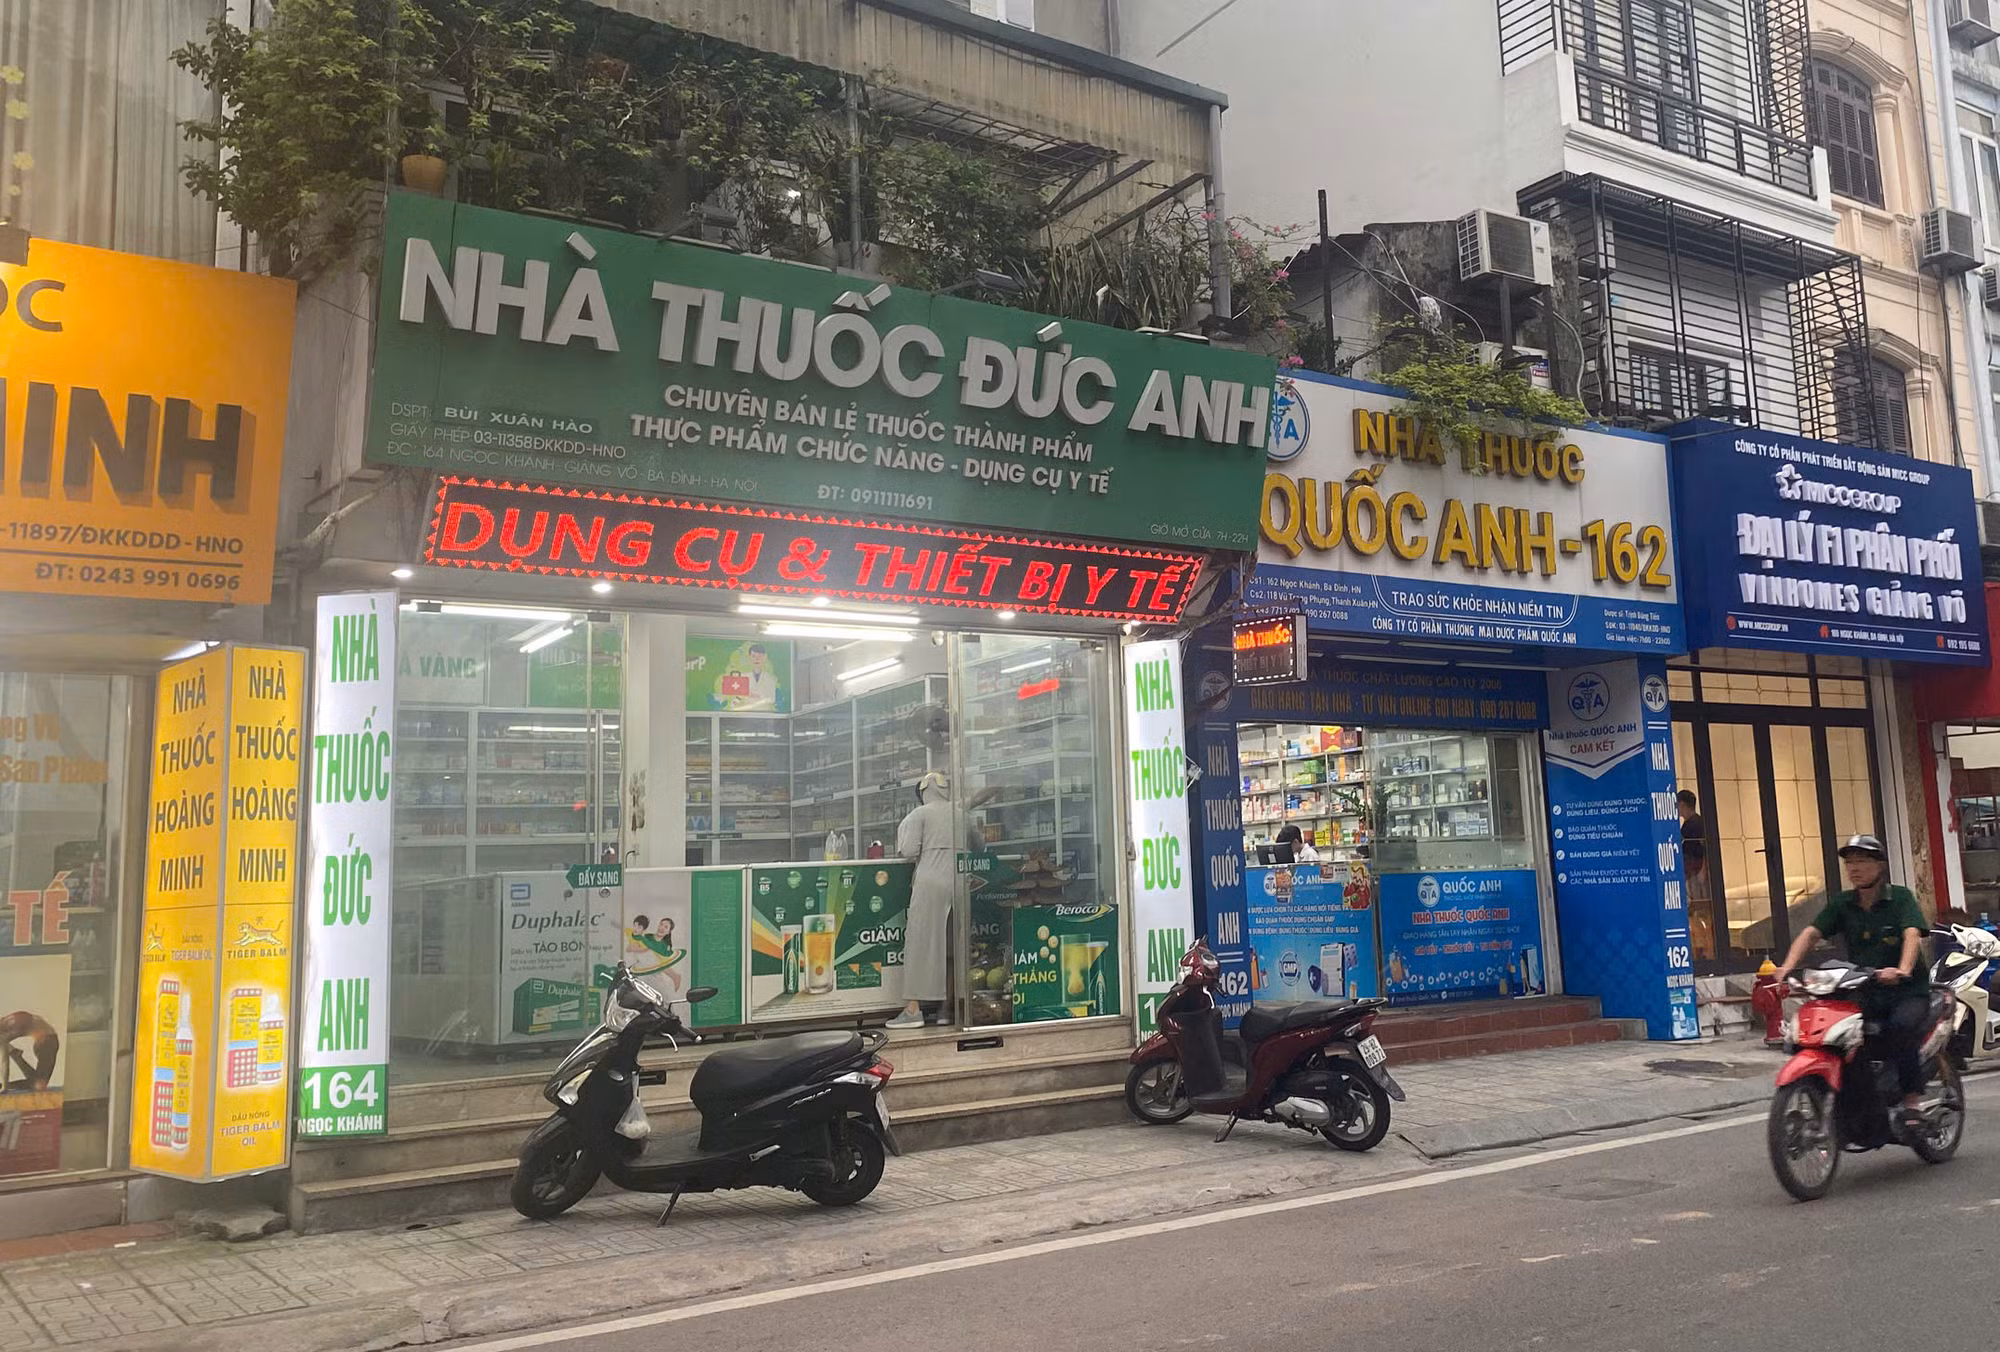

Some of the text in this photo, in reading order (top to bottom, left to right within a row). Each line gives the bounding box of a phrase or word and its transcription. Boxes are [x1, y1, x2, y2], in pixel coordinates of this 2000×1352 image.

[400, 232, 1271, 449] NHÀ THUỐC ĐỨC ANH
[444, 406, 479, 421] BÙI
[490, 411, 544, 428] XUÂN
[552, 417, 593, 434] HÀO
[664, 384, 1093, 462] CHUYÊN BÁN LẺ THUỐC THÀNH PHẨM
[0, 378, 256, 513] INH
[423, 445, 443, 458] 164
[631, 413, 1114, 494] THỰC PHẨM CHỨC NĂNG DỤNG CỤ Y TẾ
[1734, 439, 1756, 455] CÔNG
[1757, 443, 1767, 457] TY
[818, 484, 845, 501] ĐT:
[1260, 463, 1428, 560] QUỐC
[439, 501, 1188, 611] DỤNG CỤ & THIẾT BỊ Y TẾ
[1737, 510, 1963, 581] ĐẠI LÝ F1 PHÂN PHỐI
[36, 562, 240, 591] ĐT: 0243 991 0696
[1267, 577, 1279, 586] 162
[1280, 578, 1298, 589] Ngọc
[1324, 583, 1334, 591] Ba
[1352, 586, 1361, 594] HN
[1267, 590, 1278, 600] 118
[1392, 590, 1563, 619] TRAO SỨC KHỎE NHẬN NIỀM TIN
[1738, 573, 1967, 624] VINHOMES GIẢNG VÕ
[331, 598, 379, 684] NHÀ
[1236, 623, 1290, 650] NHÀ THUỐC
[1372, 615, 1393, 631] CÔNG
[1396, 619, 1405, 631] TY
[1421, 619, 1442, 634] PHẦN
[1444, 623, 1474, 637] THƯƠNG
[1479, 625, 1494, 641] MẠI
[1517, 627, 1539, 642] PHẨM
[1541, 630, 1560, 644] QUỐC
[1562, 632, 1577, 645] ANH
[249, 661, 286, 701] NHÀ
[419, 655, 478, 680] VÀNG
[1135, 648, 1175, 712] NHÀ
[173, 673, 207, 715] NHÀ
[236, 719, 297, 762] THUỐC
[1617, 722, 1637, 733] ANH
[161, 721, 215, 771] THUỐC
[314, 707, 391, 804] THUỐC
[1207, 740, 1230, 776] NHÀ
[1570, 738, 1616, 755] CAM KẾT
[1650, 738, 1670, 771] NHÀ
[1131, 727, 1184, 801] THUỐC
[155, 791, 214, 834] HOÀNG
[232, 780, 298, 822] HOÀNG
[1205, 791, 1240, 831] THUỐC
[1651, 784, 1678, 821] THUỐC
[159, 855, 203, 892] MINH
[238, 848, 287, 883] MINH
[973, 859, 990, 871] SANG
[1141, 822, 1182, 891] ĐỨC
[1210, 846, 1240, 891] QUỐC
[323, 833, 373, 927] ĐỨC
[578, 868, 619, 886] ĐẨY SANG
[759, 884, 770, 892] B5
[1443, 876, 1502, 894] QUỐC ANH
[1055, 904, 1100, 916] Berocca
[1664, 881, 1682, 910] ANH
[512, 910, 601, 933] Duphalac
[1217, 912, 1241, 945] ANH
[1412, 905, 1510, 925] NHÀ THUỐC QUỐC ANH
[859, 926, 899, 944] GIẢM
[227, 948, 287, 959] TIGER BALM
[1147, 928, 1187, 983] ANH
[1667, 946, 1690, 969] 162
[1218, 971, 1249, 996] 162
[318, 978, 369, 1053] ANH
[304, 1071, 378, 1111] 164
[220, 1121, 280, 1138] TIGER BALM
[297, 1112, 384, 1136] NGỌC KHÁNH
